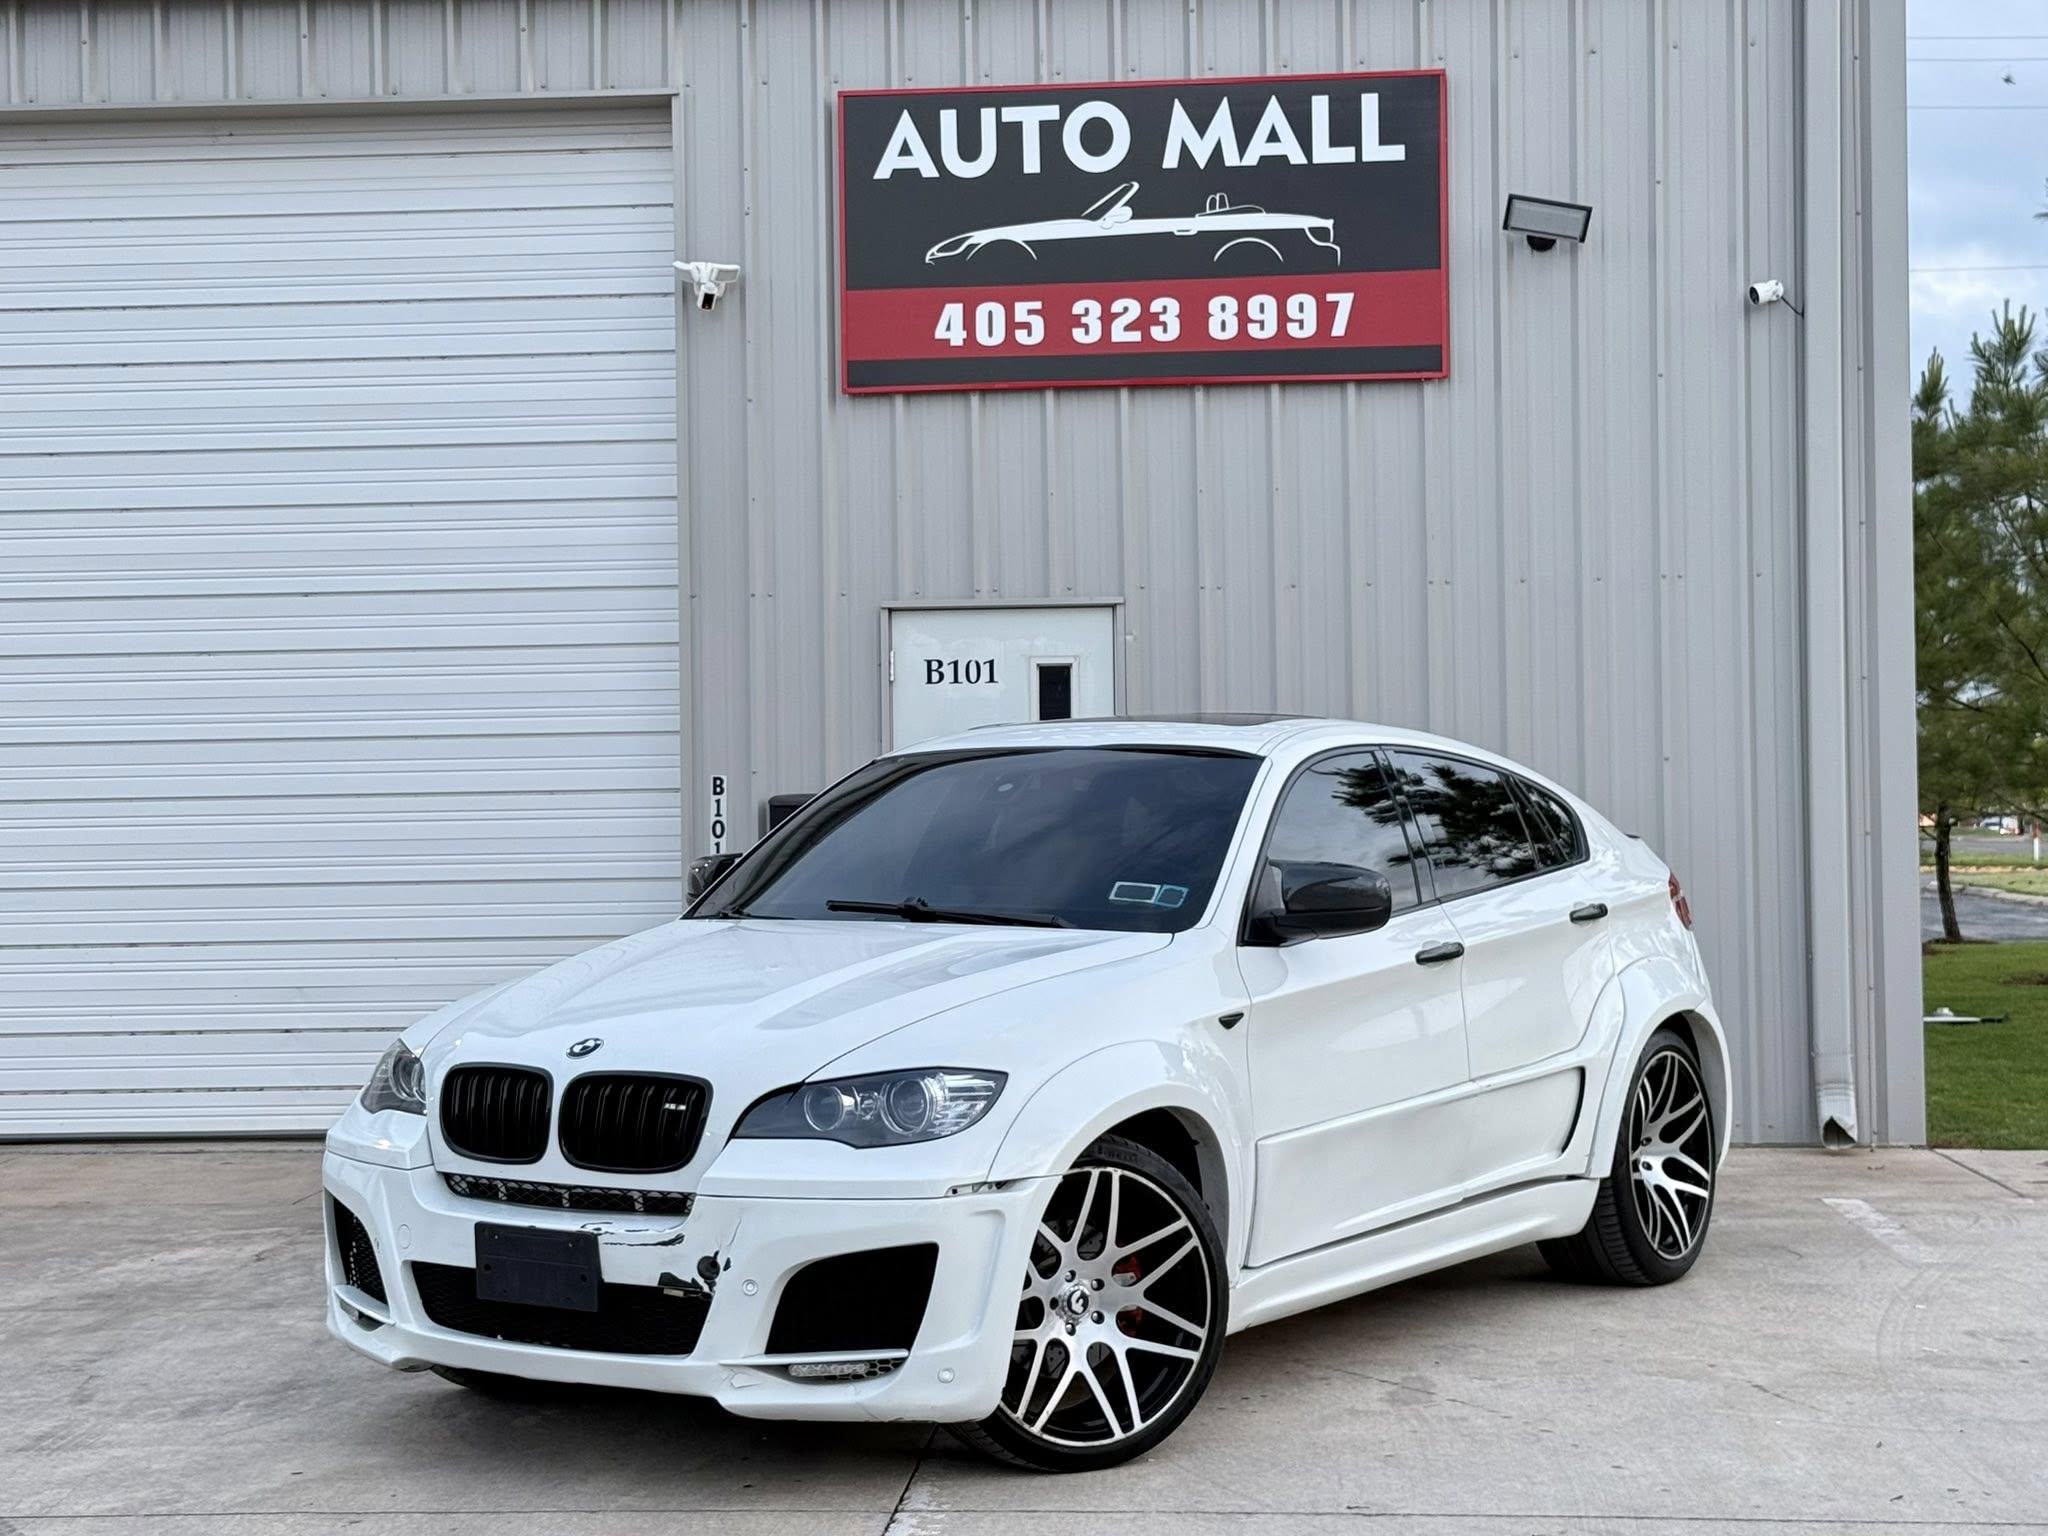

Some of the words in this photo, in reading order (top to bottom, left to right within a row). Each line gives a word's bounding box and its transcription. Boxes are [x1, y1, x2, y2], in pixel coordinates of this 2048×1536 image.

[873, 101, 1131, 180] AUTO
[1162, 93, 1406, 169] MALL
[934, 300, 1045, 347] 405
[1071, 297, 1181, 343] 323
[1208, 292, 1355, 340] 8997
[925, 658, 998, 685] B101
[711, 776, 726, 854] B101
